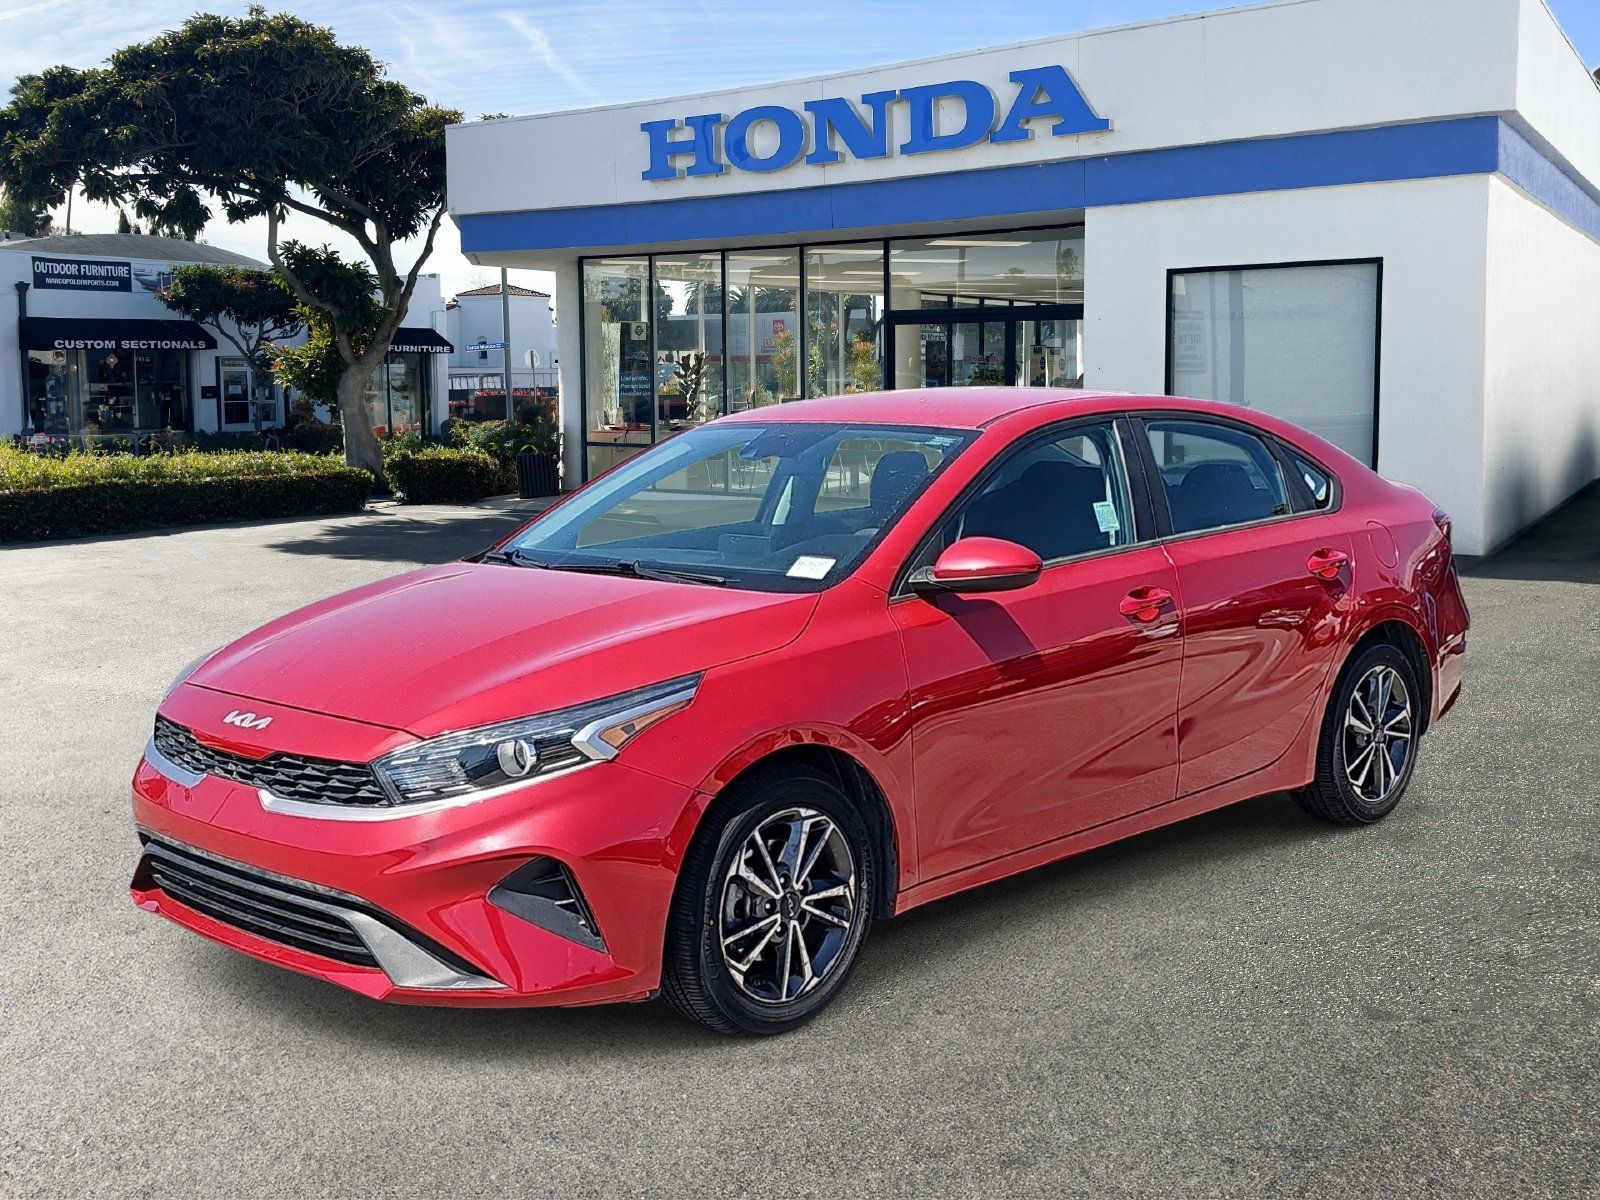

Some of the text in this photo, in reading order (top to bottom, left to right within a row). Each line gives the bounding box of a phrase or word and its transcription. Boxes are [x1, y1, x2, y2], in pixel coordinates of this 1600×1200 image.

[640, 65, 1112, 181] HONDA
[34, 261, 130, 278] OUTDOOR FURNITURE
[45, 277, 119, 287] MARCOPOLOIMPORTS.COM
[54, 339, 206, 349] CUSTOM SECTIONALS
[223, 709, 273, 730] KIA
